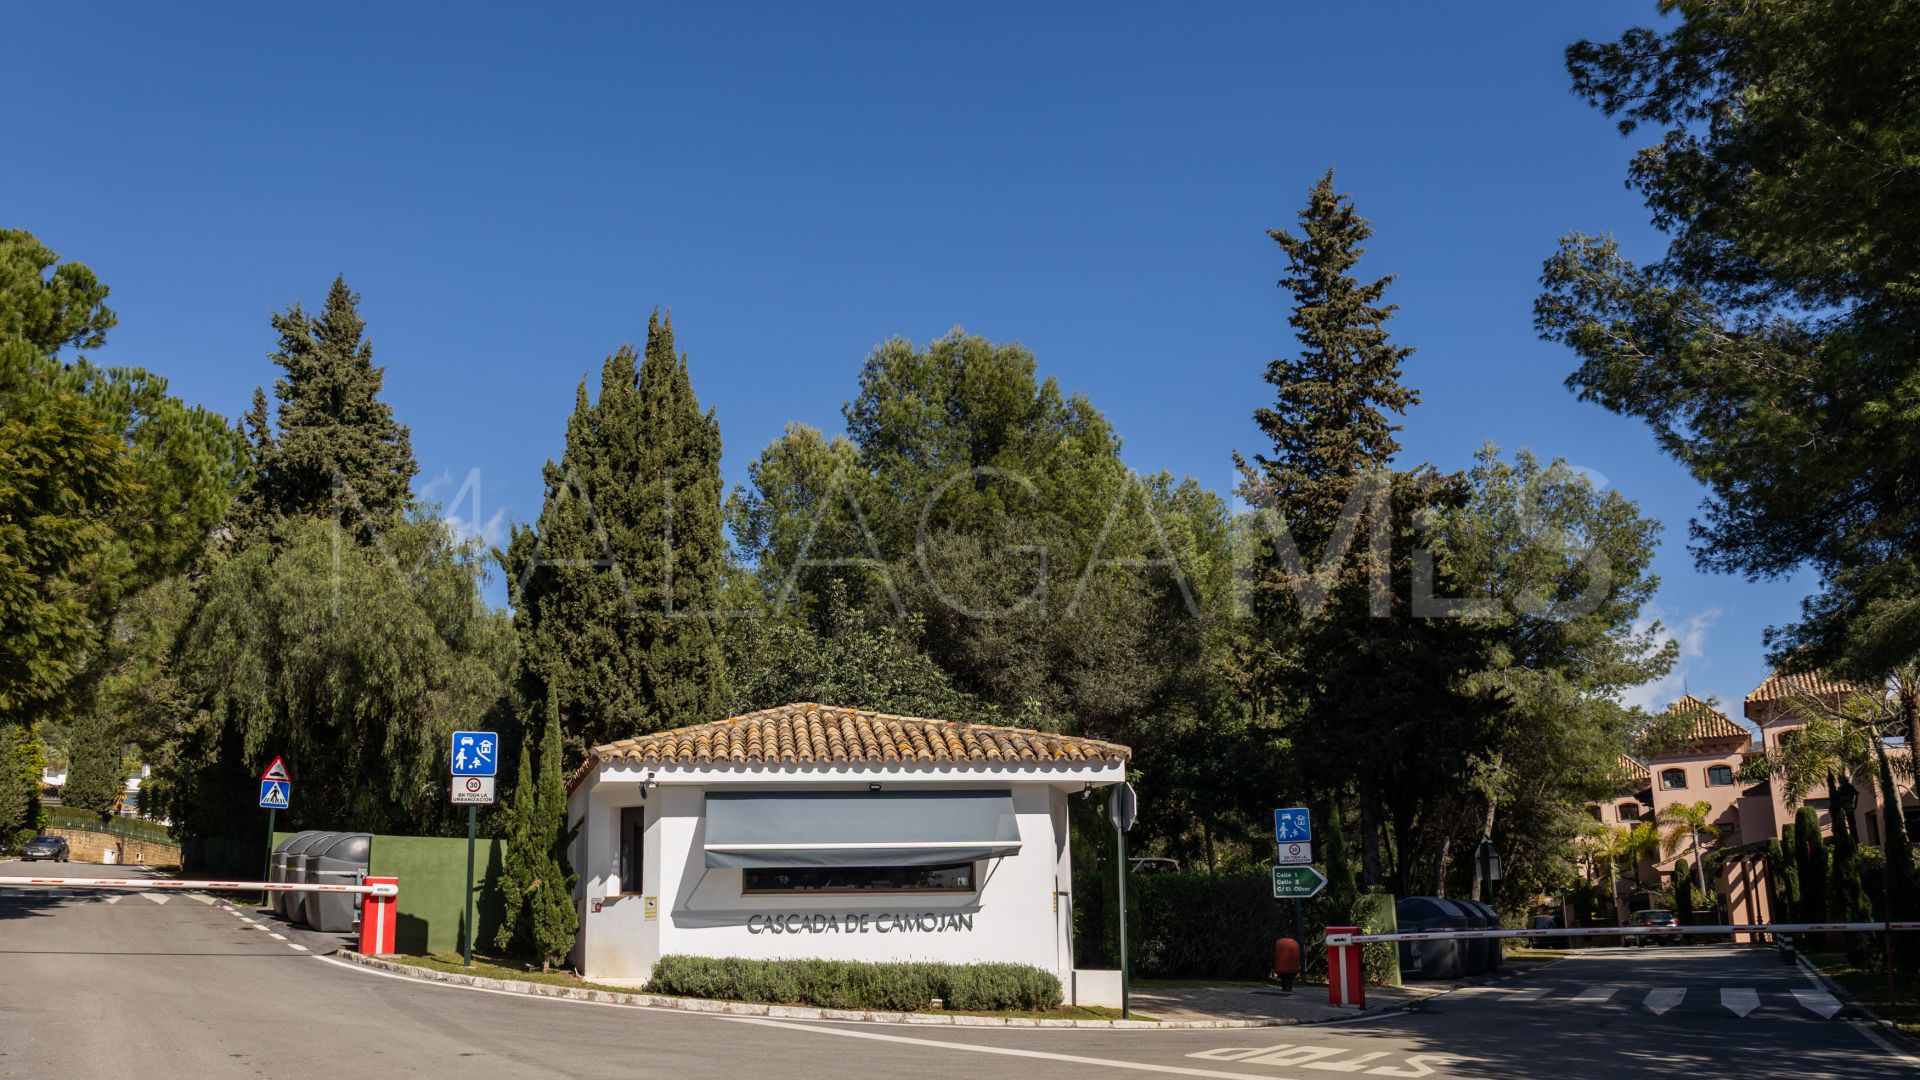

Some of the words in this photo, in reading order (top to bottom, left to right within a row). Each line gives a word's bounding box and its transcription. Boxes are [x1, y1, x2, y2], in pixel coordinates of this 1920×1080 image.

[747, 914, 840, 935] CASCADA
[845, 913, 870, 934] DE
[876, 912, 973, 933] CAMOJAN
